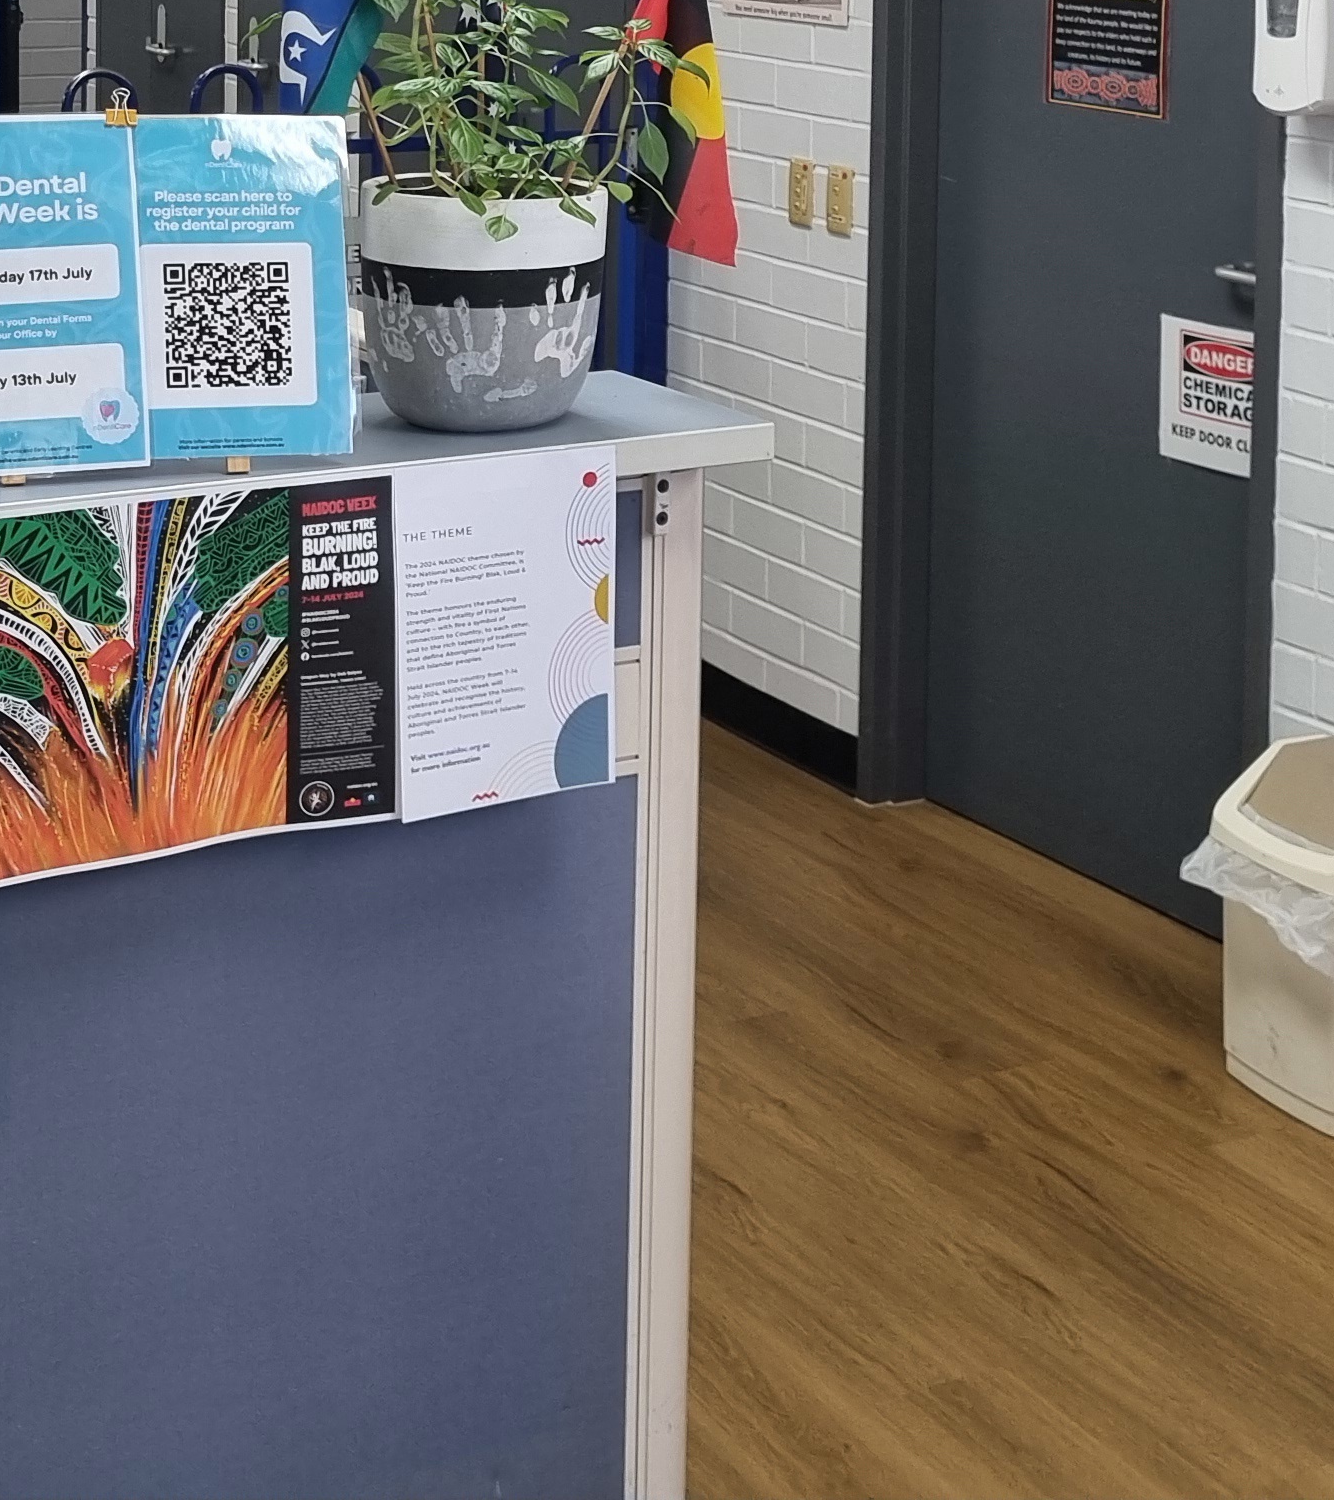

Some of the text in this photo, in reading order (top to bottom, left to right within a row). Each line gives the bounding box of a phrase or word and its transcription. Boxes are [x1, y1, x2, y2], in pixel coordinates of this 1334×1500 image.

[155, 190, 292, 202] Please scan here to
[76, 198, 98, 220] is
[147, 204, 301, 219] register your child for
[154, 219, 294, 233] the dental program
[29, 269, 58, 281] 17th
[62, 267, 93, 280] July
[7, 318, 27, 327] your
[30, 316, 60, 325] Dental
[63, 315, 92, 323] Forms
[14, 330, 43, 339] Office
[45, 329, 57, 339] by
[12, 374, 41, 386] 13th
[46, 372, 77, 385] July
[1184, 376, 1253, 403] CHEMICA
[1183, 393, 1253, 421] STORAG
[1172, 424, 1195, 438] KEEP
[1199, 430, 1232, 449] DOOR
[302, 496, 377, 517] NAIDOC WEEK
[302, 517, 376, 536] KEEP THE FIRE
[403, 526, 473, 542] THE THEME
[302, 531, 377, 556] BURNING!
[302, 552, 378, 573] BLAK, LOUD
[439, 557, 466, 566] NAIDOC
[302, 569, 379, 590] AND PROUD
[322, 592, 342, 601] JULY
[344, 591, 363, 600] 2024
